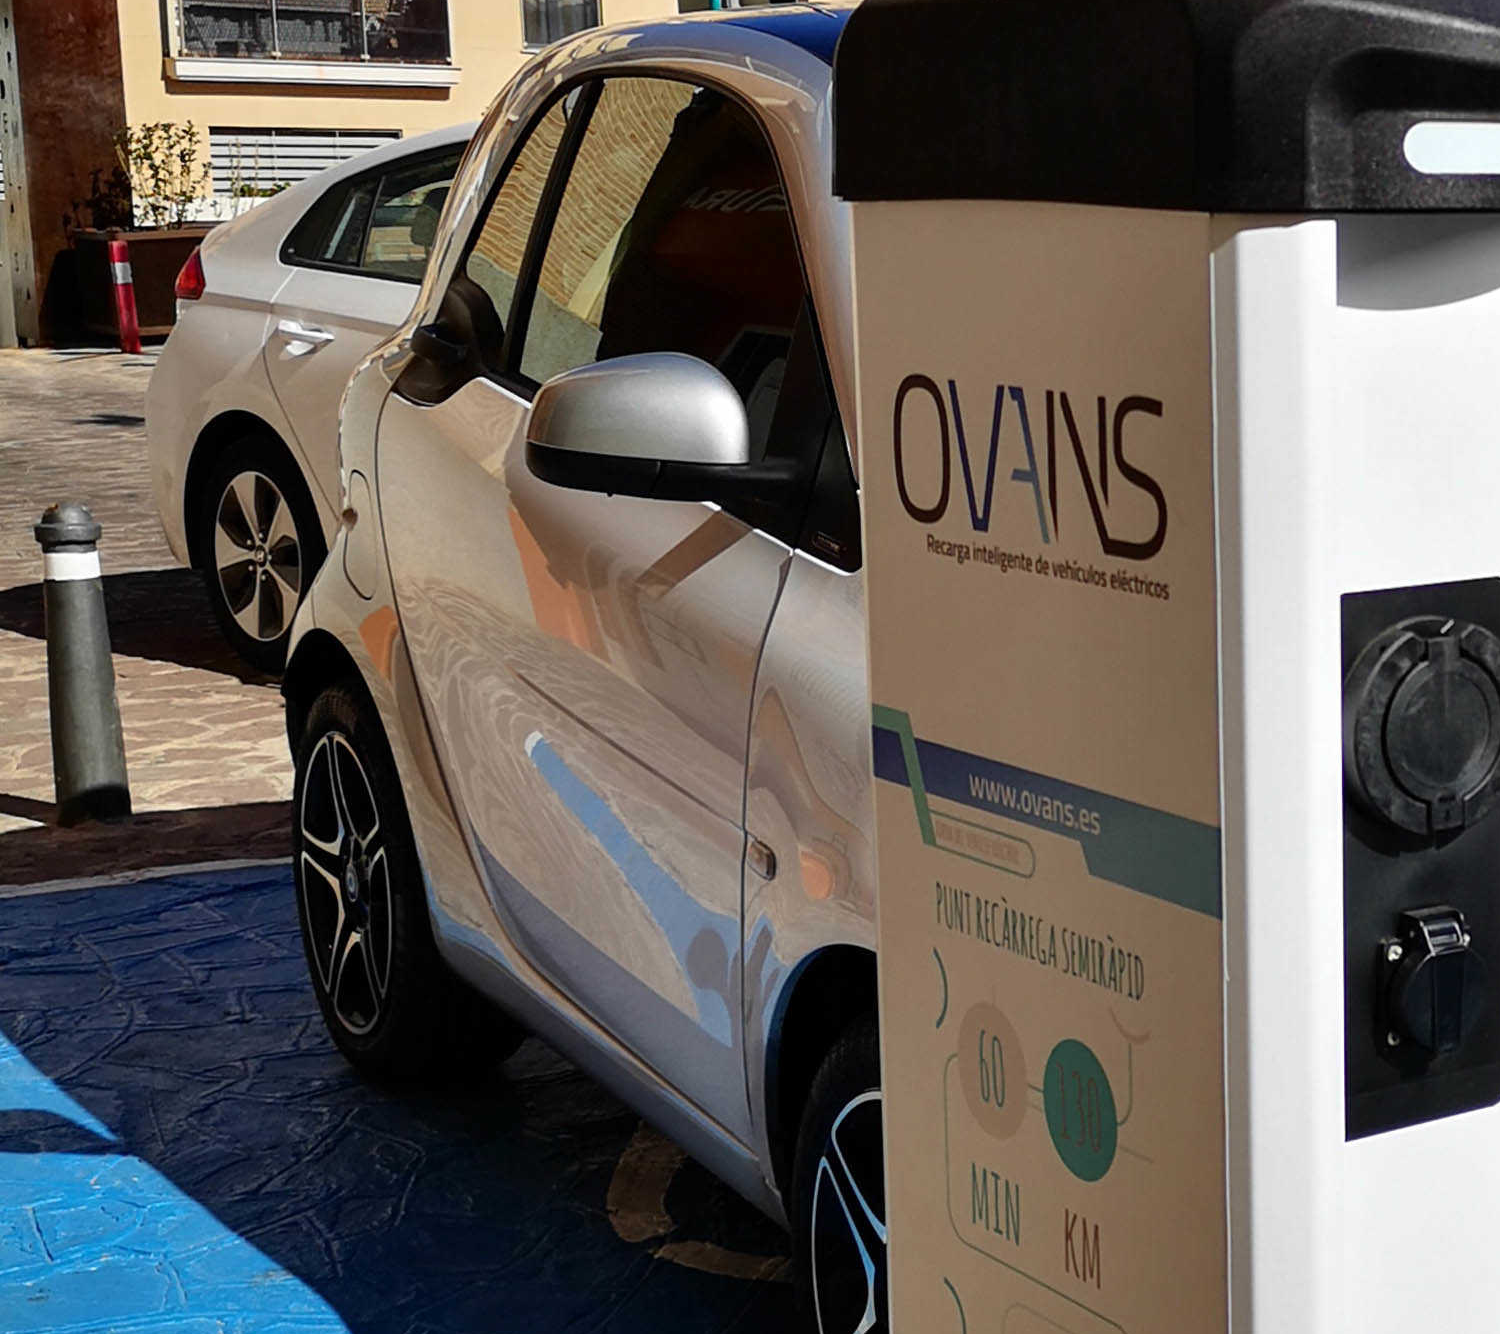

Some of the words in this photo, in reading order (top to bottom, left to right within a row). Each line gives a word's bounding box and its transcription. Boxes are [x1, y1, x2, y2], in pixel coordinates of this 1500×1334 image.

[893, 373, 1168, 561] OVANS
[926, 534, 971, 564] Recarga
[973, 542, 1033, 572] inteligente
[1035, 554, 1049, 576] de
[1051, 559, 1107, 588] vehículos
[1110, 570, 1170, 600] eléctricos
[968, 772, 1101, 835] www.ovans.es
[935, 881, 972, 933] PUNT
[976, 897, 1058, 969] RECÀRREGA
[980, 1029, 1005, 1108] 60
[1055, 1060, 1101, 1153] 130
[971, 1162, 1020, 1247] MIN
[1064, 1208, 1101, 1290] KM
